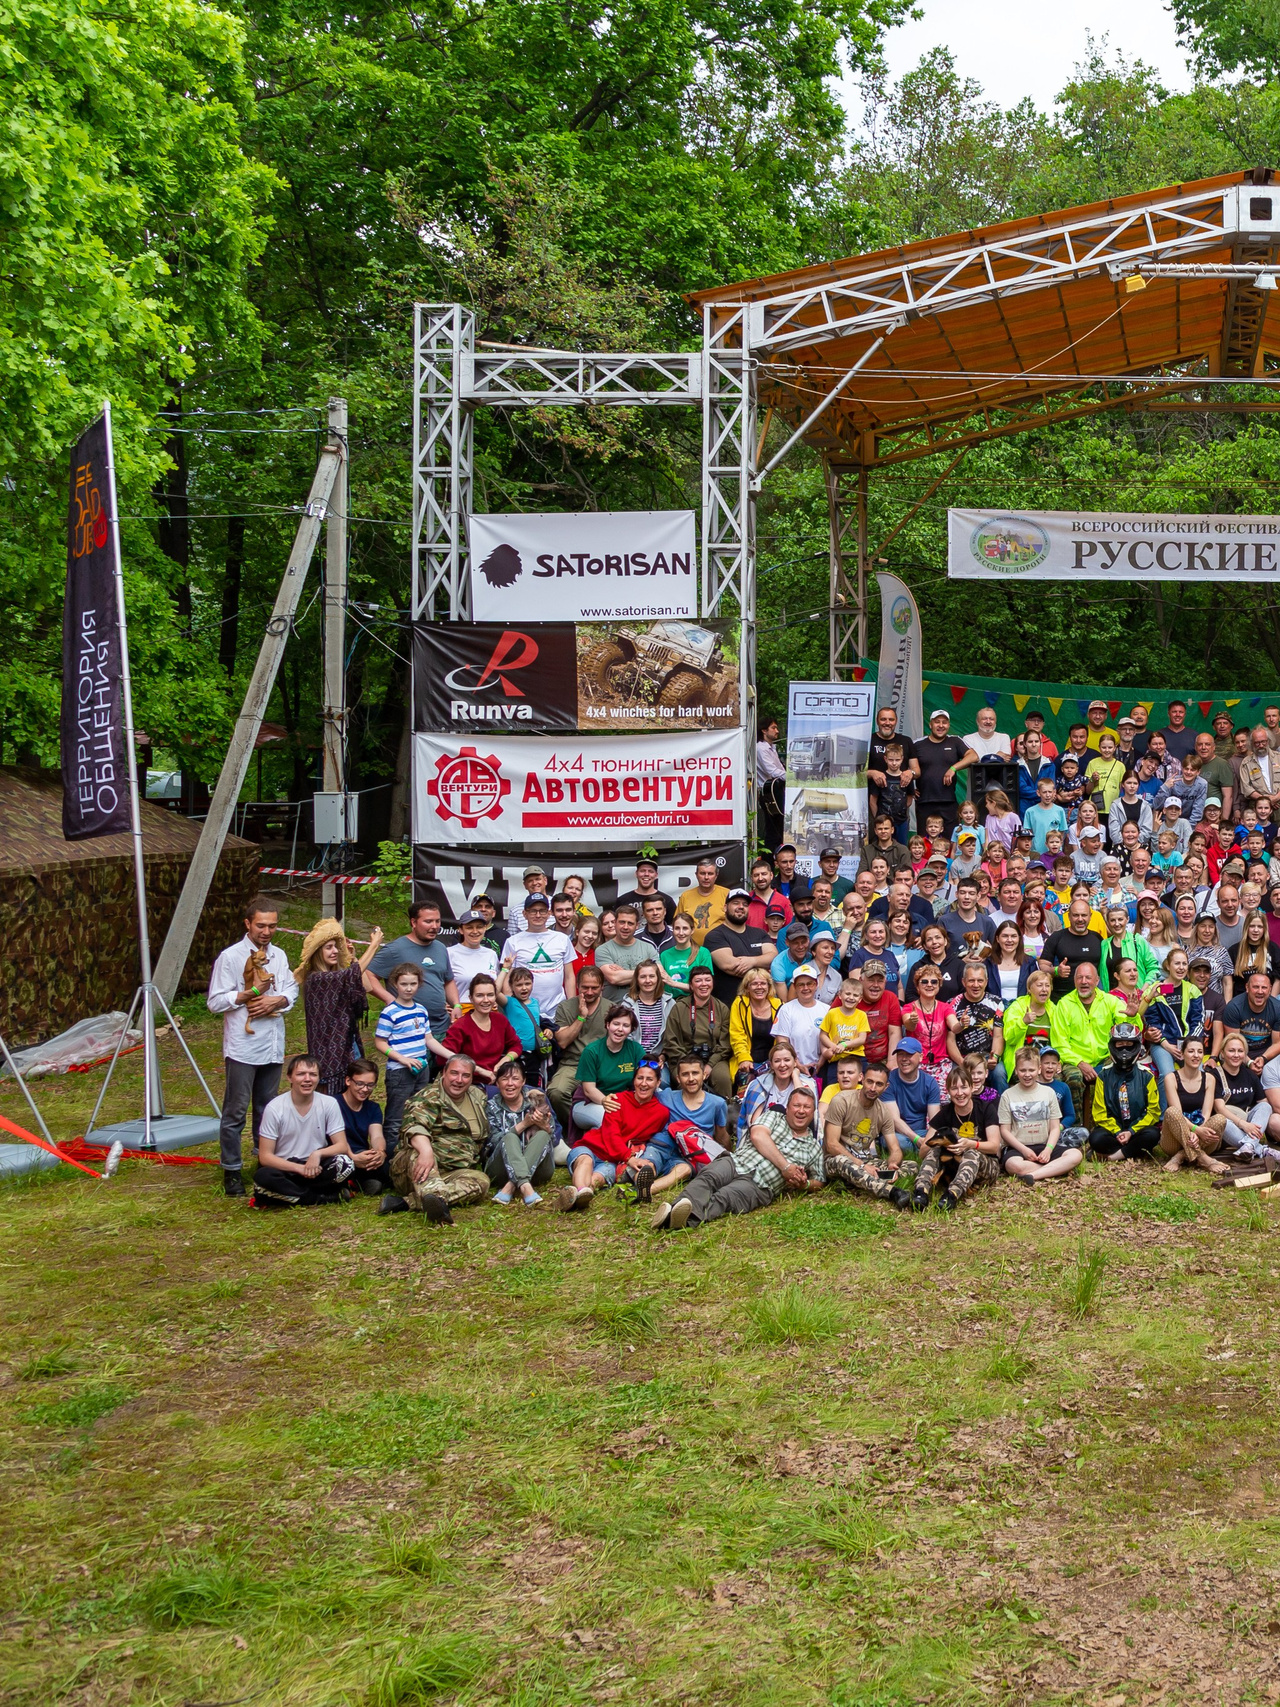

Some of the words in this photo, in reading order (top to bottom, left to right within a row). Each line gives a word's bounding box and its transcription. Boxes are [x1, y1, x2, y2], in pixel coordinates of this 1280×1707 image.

[1072, 519, 1210, 535] ВСЕРОССИЙСКИЙ
[532, 552, 691, 578] SATORISAN
[973, 552, 1011, 573] РУССКИЕ
[1013, 554, 1047, 573] ДОРОГИ
[1071, 540, 1278, 572] РУССКИЕ
[580, 604, 689, 617] www.satorisan.ru
[77, 608, 97, 820] ТЕРРИТОРИЯ
[450, 701, 533, 720] Runva
[586, 705, 607, 718] 4x4
[610, 704, 656, 717] winches
[659, 704, 675, 717] for
[678, 703, 703, 717] hard
[706, 703, 733, 717] work
[93, 641, 118, 814] ОБЩЕНИЯ
[592, 756, 732, 773] тюнинг-центр
[441, 784, 498, 792] ВЕНТУРИ
[522, 772, 733, 807] Автовентури
[567, 811, 690, 826] www.autoventuri.ru
